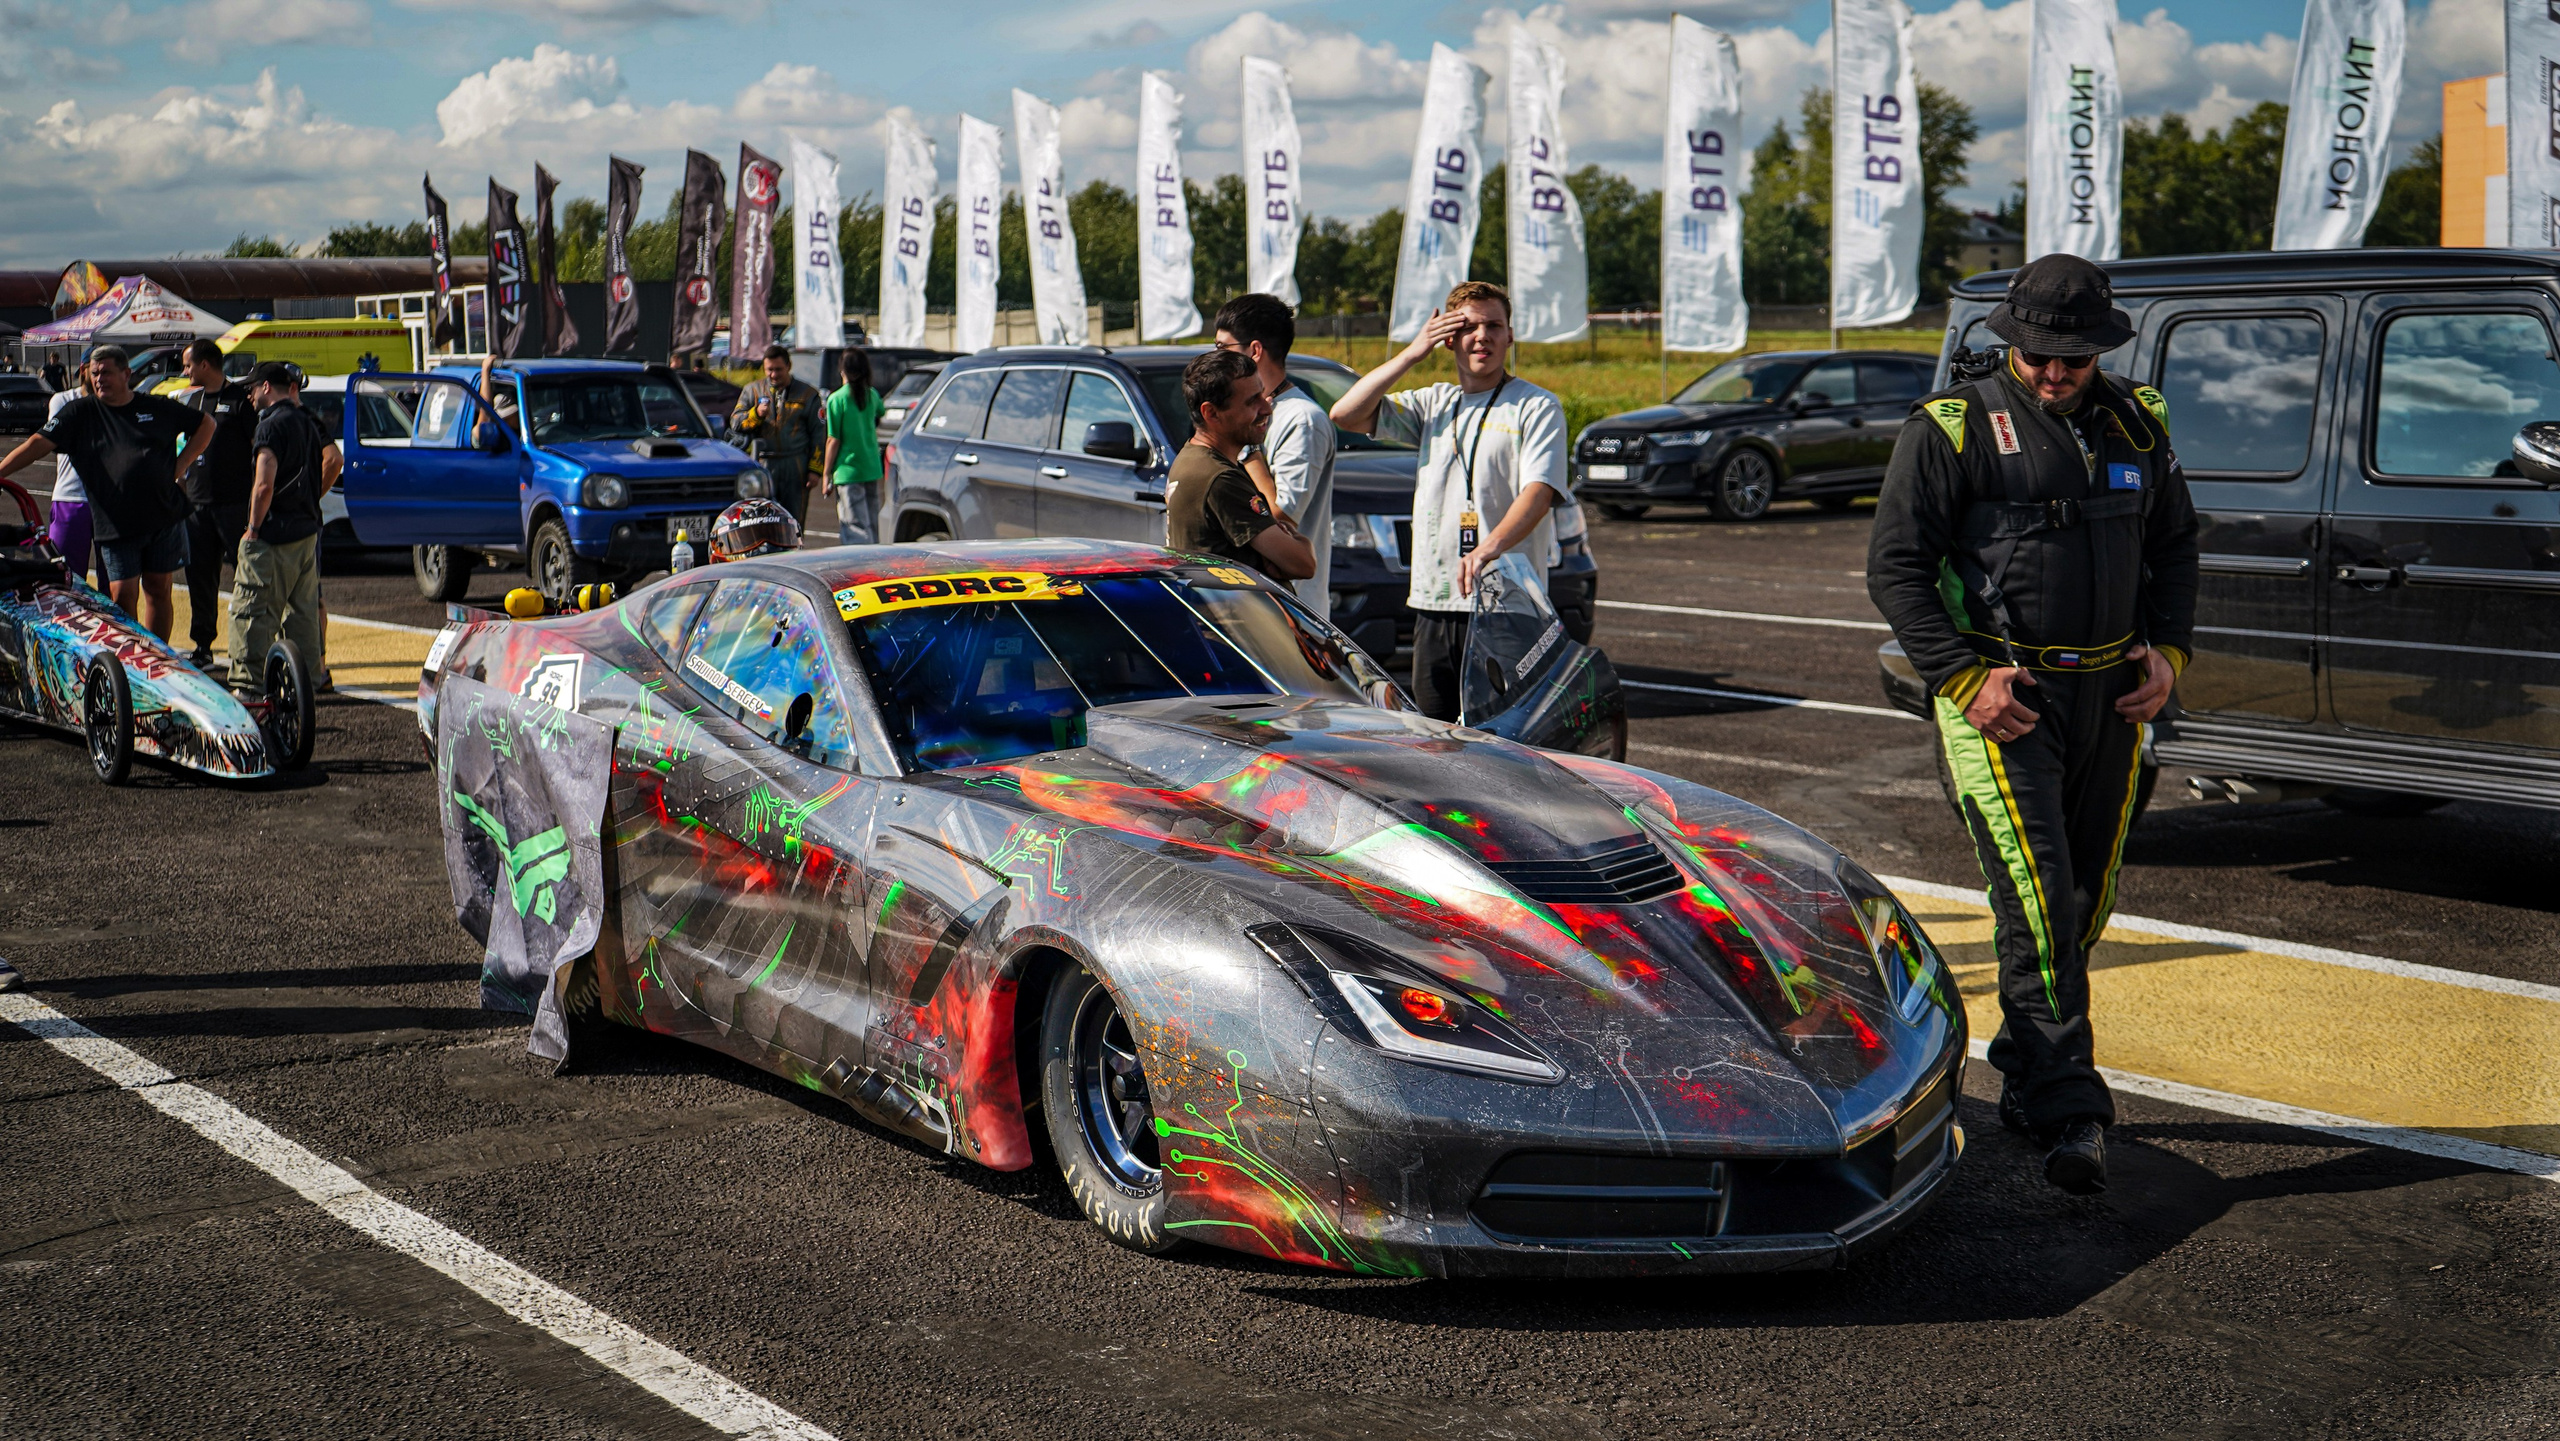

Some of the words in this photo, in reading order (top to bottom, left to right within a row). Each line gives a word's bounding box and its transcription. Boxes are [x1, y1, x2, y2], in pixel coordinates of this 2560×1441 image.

[1864, 94, 1902, 183] ВТБ
[2070, 63, 2096, 225] МОНОЛИТ
[2326, 36, 2375, 210] МОНОЛИТ
[1264, 149, 1288, 221] ВТБ
[1430, 146, 1466, 224] ВТБ
[1687, 129, 1726, 212] ВТБ
[810, 210, 830, 268] ВТБ
[900, 196, 923, 258] ВТБ
[972, 196, 990, 258] ВТБ
[1996, 415, 2013, 449] SIMPSON
[739, 516, 780, 528] SIMPSON
[871, 576, 1027, 604] RDRC
[1206, 567, 1257, 586] 99
[539, 681, 561, 706] 99
[687, 656, 727, 688] SAVINOV
[724, 681, 764, 712] SERGEY
[1115, 1180, 1163, 1200] RACING
